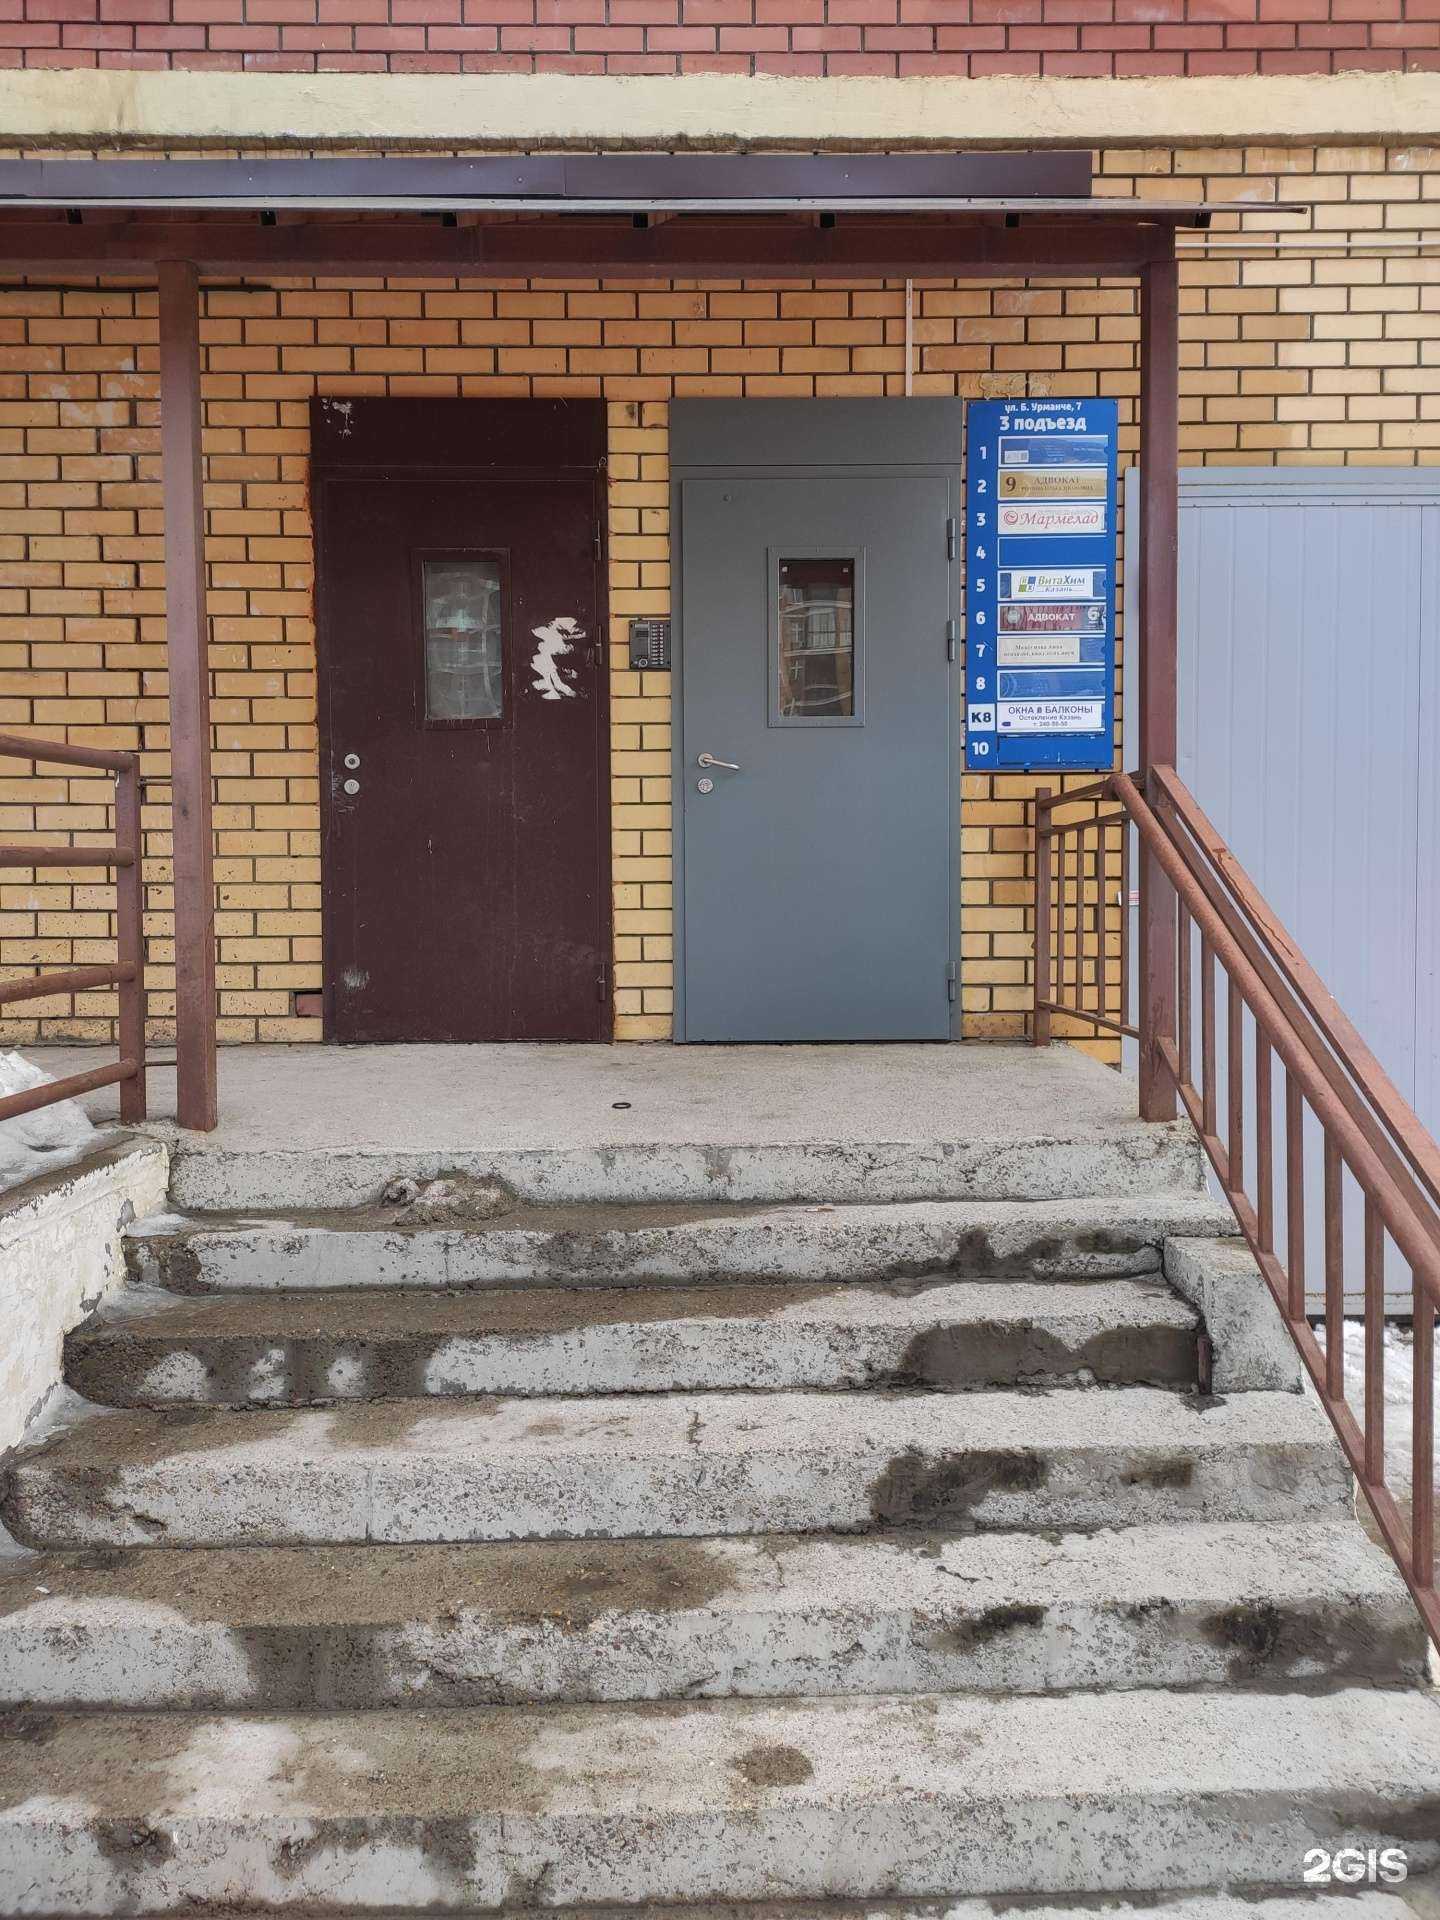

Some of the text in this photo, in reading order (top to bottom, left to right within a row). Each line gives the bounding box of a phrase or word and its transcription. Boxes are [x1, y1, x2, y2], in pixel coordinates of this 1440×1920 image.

[1005, 402, 1082, 414] ул. Б. Урманче, 7
[1000, 416, 1087, 432] 3 подъезд
[979, 446, 987, 459] 1
[977, 480, 987, 493] 2
[1006, 476, 1016, 492] 9
[976, 513, 986, 526] 3
[1020, 511, 1099, 529] Мармелад
[976, 546, 986, 560] 4
[976, 579, 986, 592] 5
[976, 611, 986, 625] 6
[1027, 613, 1076, 622] АДВОКАТ
[976, 644, 986, 657] 7
[976, 677, 986, 690] 8
[1008, 706, 1034, 714] ОКНА
[1045, 705, 1093, 714] БАЛКОНЫ
[972, 742, 989, 755] 10
